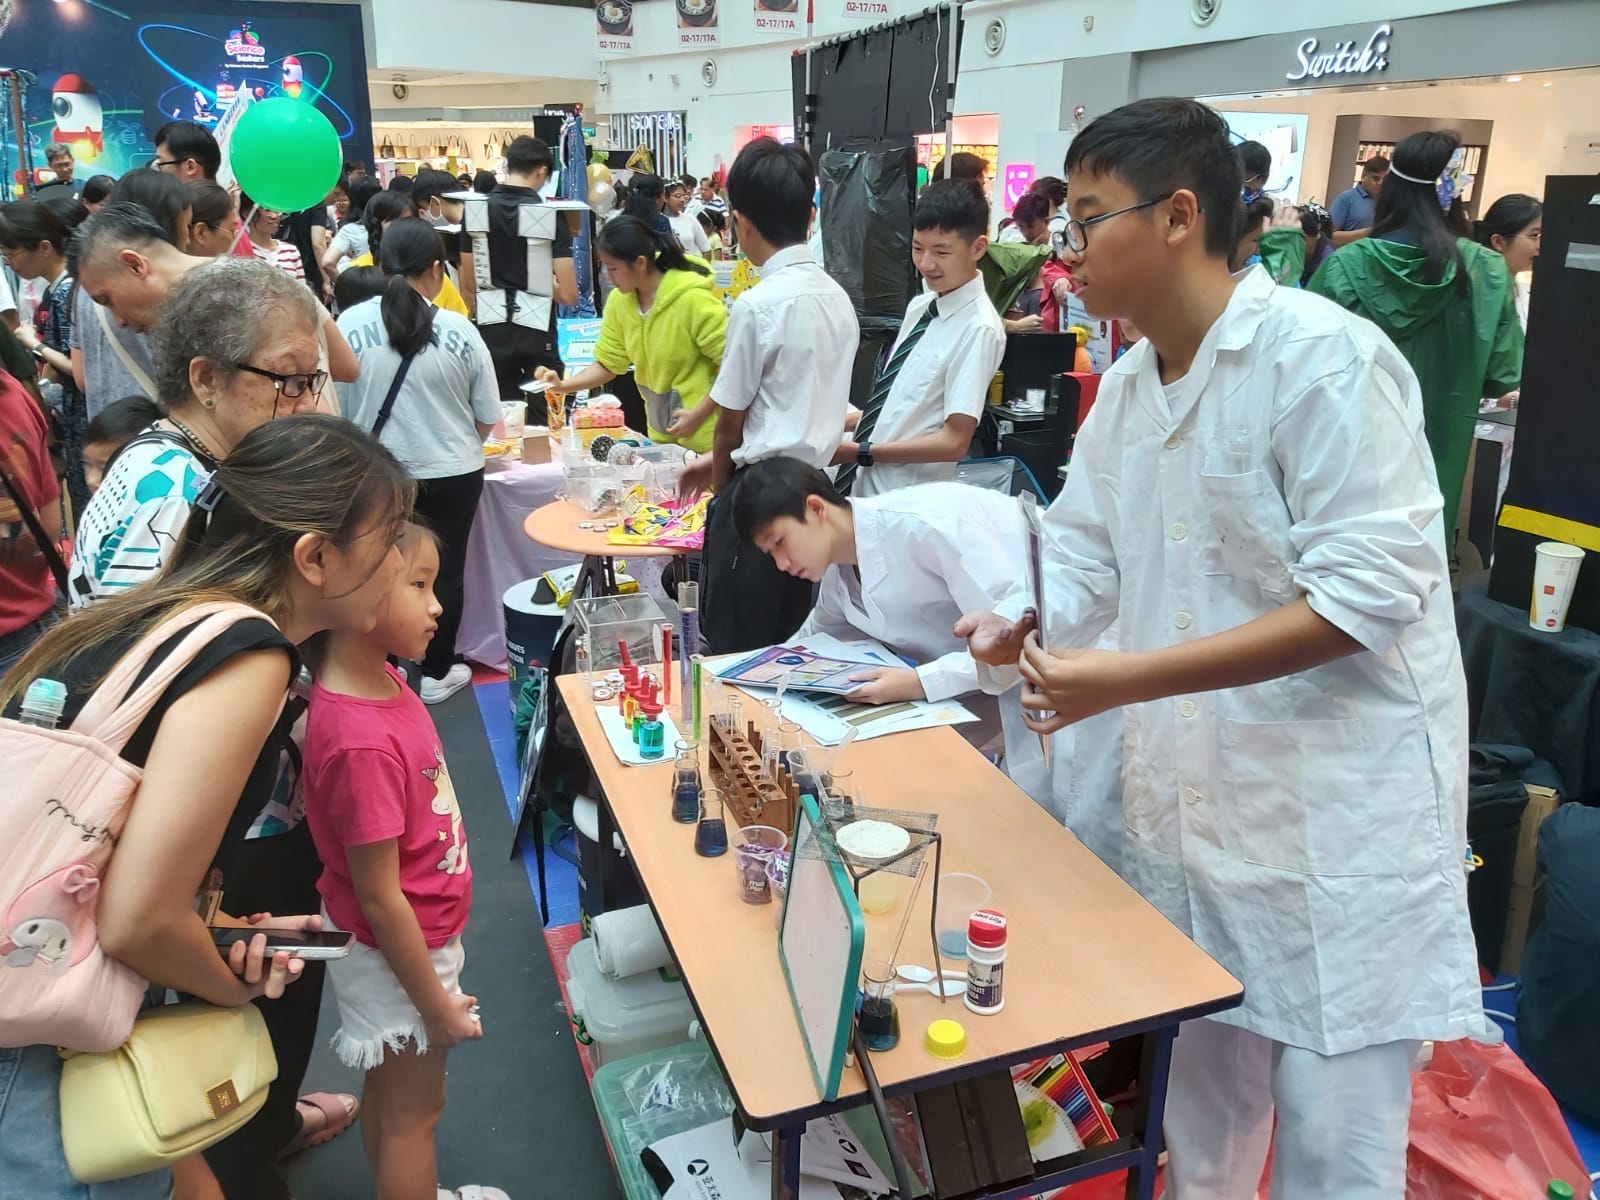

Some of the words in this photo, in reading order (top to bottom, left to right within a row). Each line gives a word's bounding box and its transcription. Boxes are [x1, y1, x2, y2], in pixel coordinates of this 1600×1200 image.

[846, 2, 887, 13] 02-17/17A
[756, 19, 795, 29] 02-17/17A
[681, 34, 716, 43] 02-17/17A
[225, 43, 265, 56] Science
[599, 41, 631, 50] 02-17/17A
[1285, 24, 1391, 80] Switch
